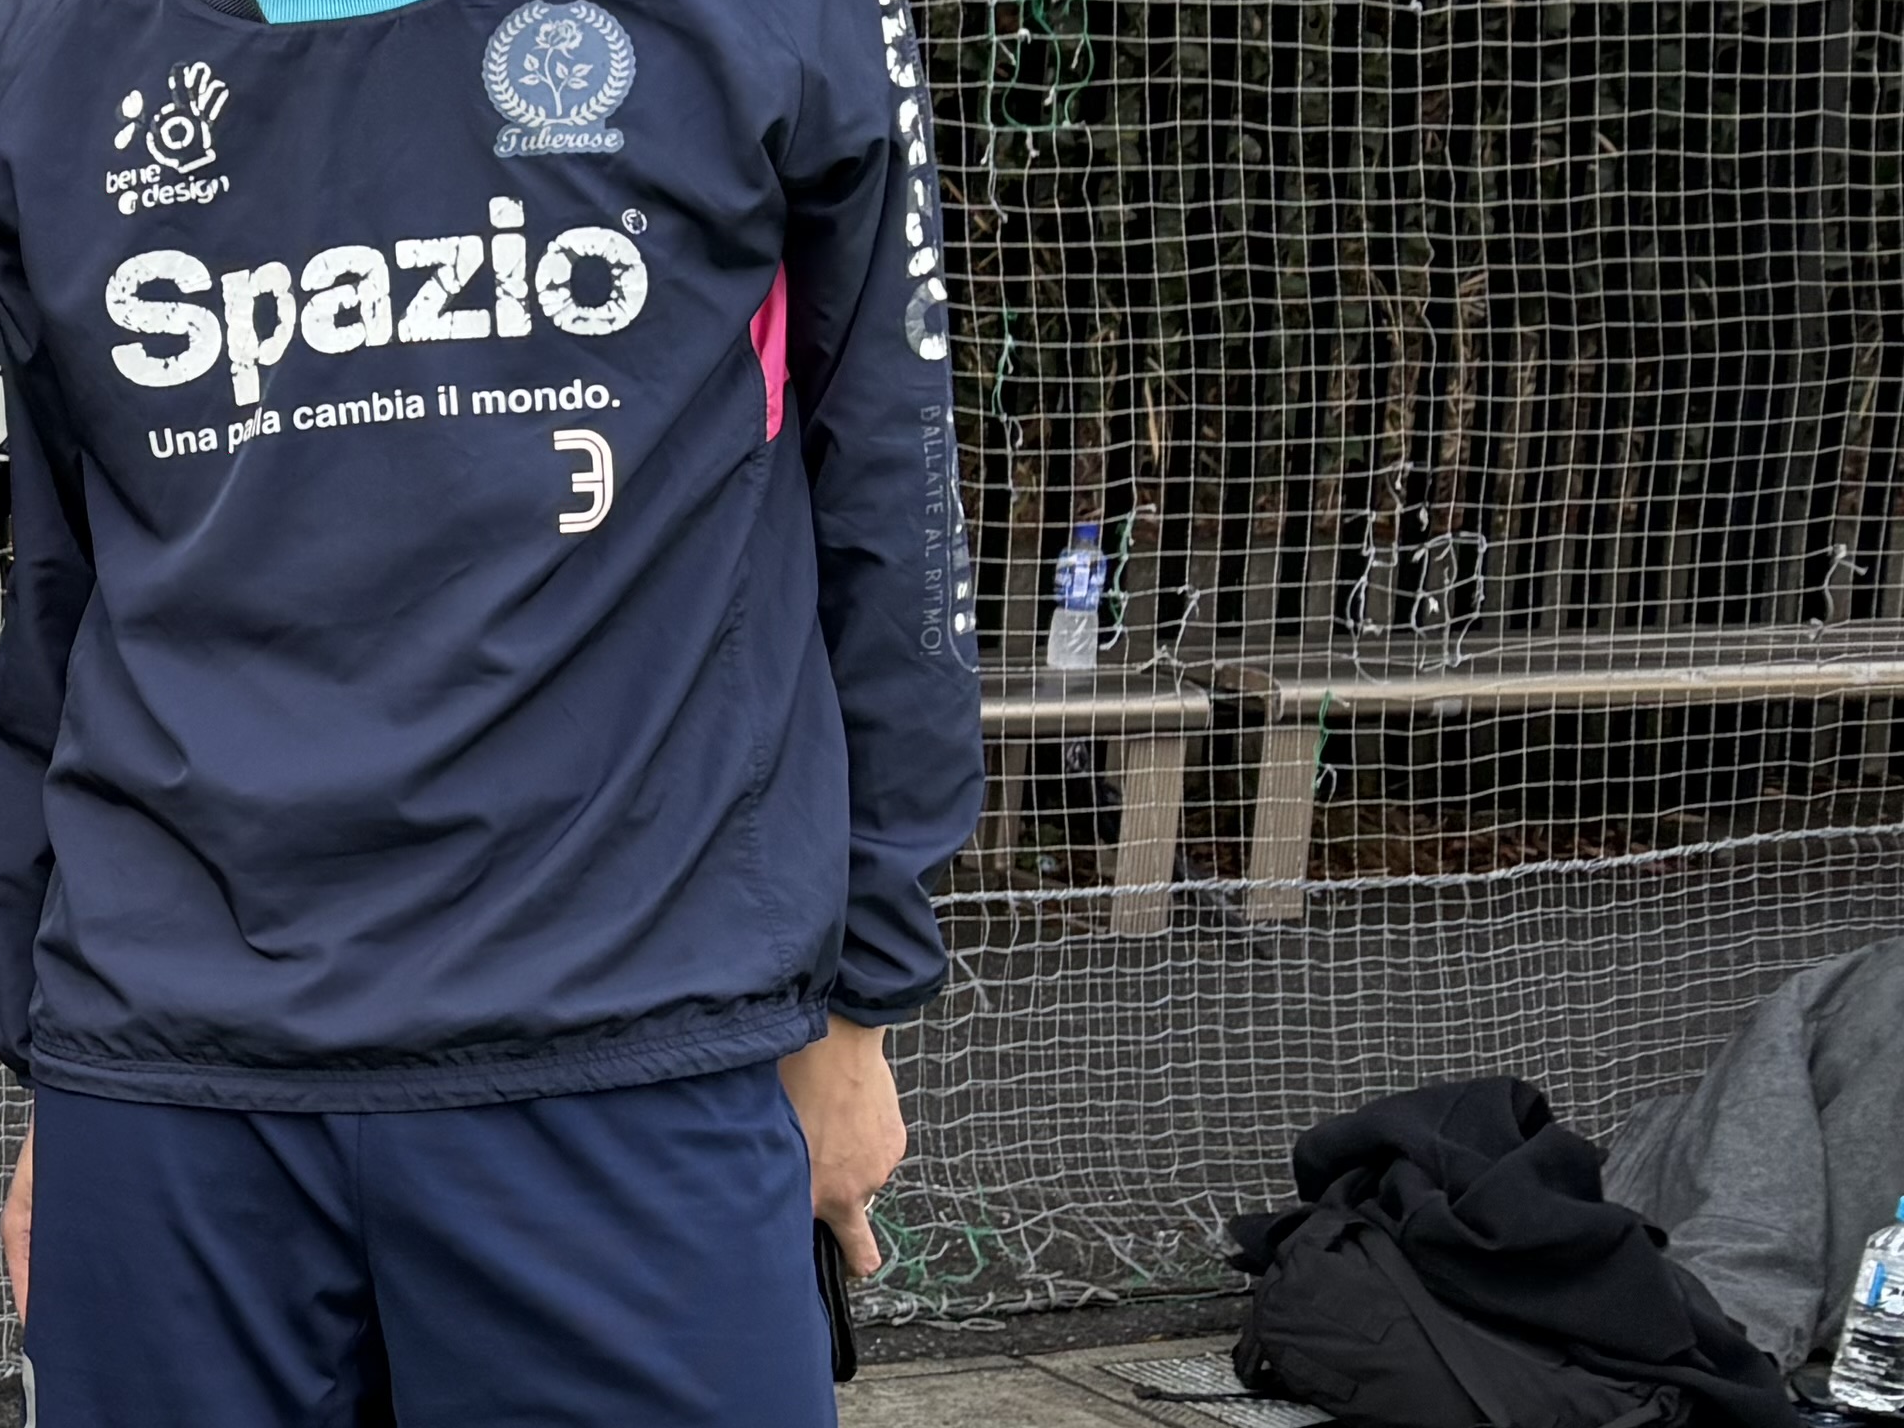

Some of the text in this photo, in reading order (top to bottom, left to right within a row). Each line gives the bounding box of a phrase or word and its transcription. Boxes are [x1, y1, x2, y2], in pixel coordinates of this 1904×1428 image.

[499, 125, 619, 154] Tuberose
[104, 196, 649, 406] Spazio
[148, 379, 621, 459] Una palla cambia il mondo.
[920, 404, 944, 516] BALLATE
[553, 428, 614, 534] 3
[924, 528, 941, 558] AL
